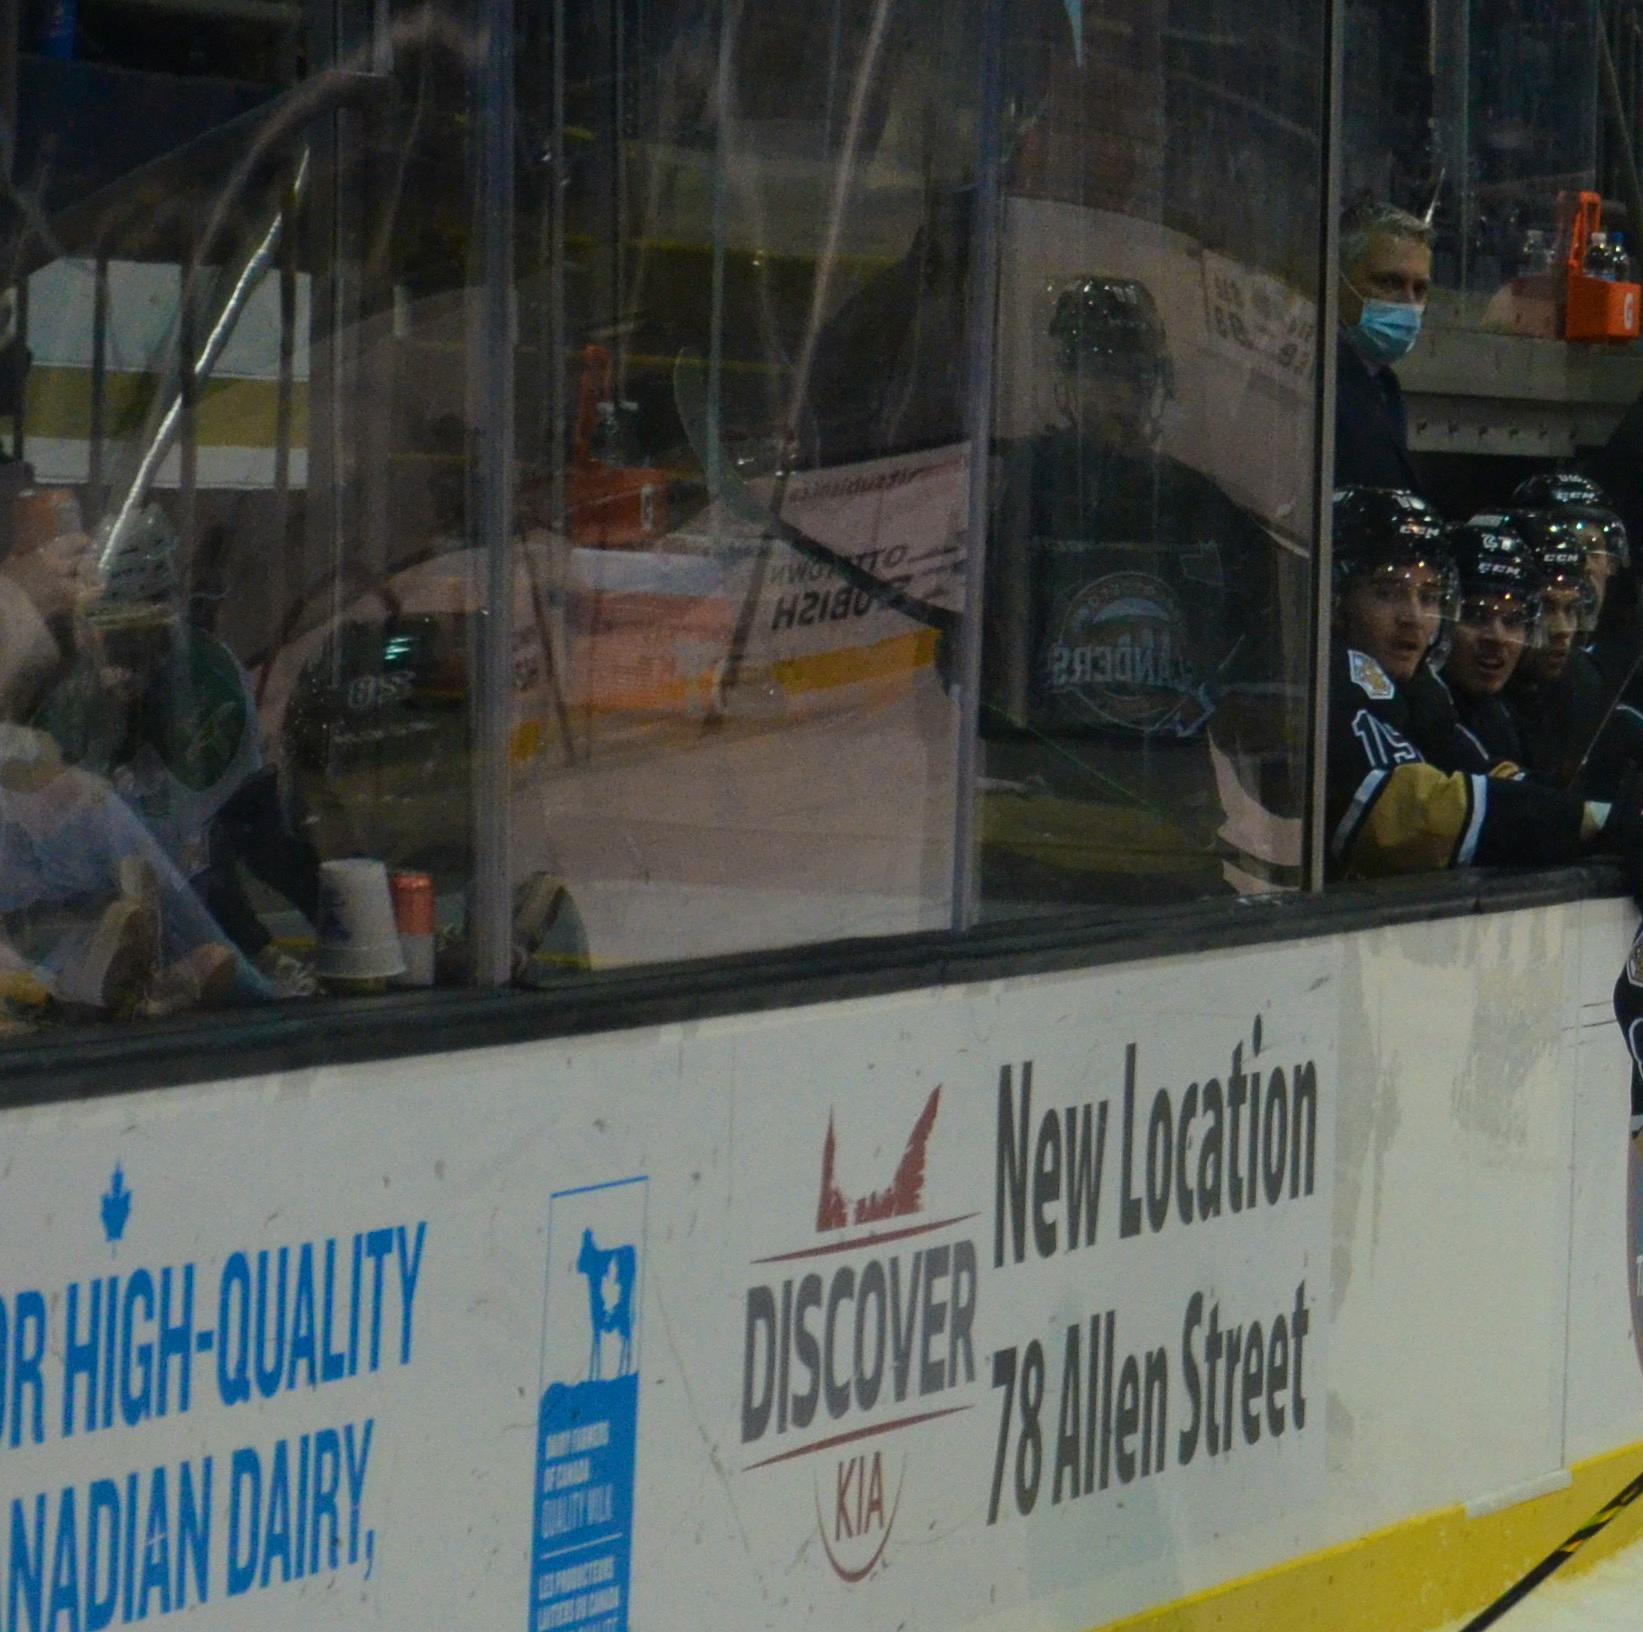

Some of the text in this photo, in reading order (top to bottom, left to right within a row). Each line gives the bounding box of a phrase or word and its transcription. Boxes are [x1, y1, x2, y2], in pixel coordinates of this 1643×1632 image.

[994, 1013, 1318, 1269] New Location
[0, 1220, 427, 1449] R HIGH-QUALITY
[740, 1239, 979, 1446] DISCOVER
[986, 1278, 1311, 1527] 78 Allen Street
[227, 1418, 375, 1598] DAIRY,
[833, 1451, 886, 1542] KIA
